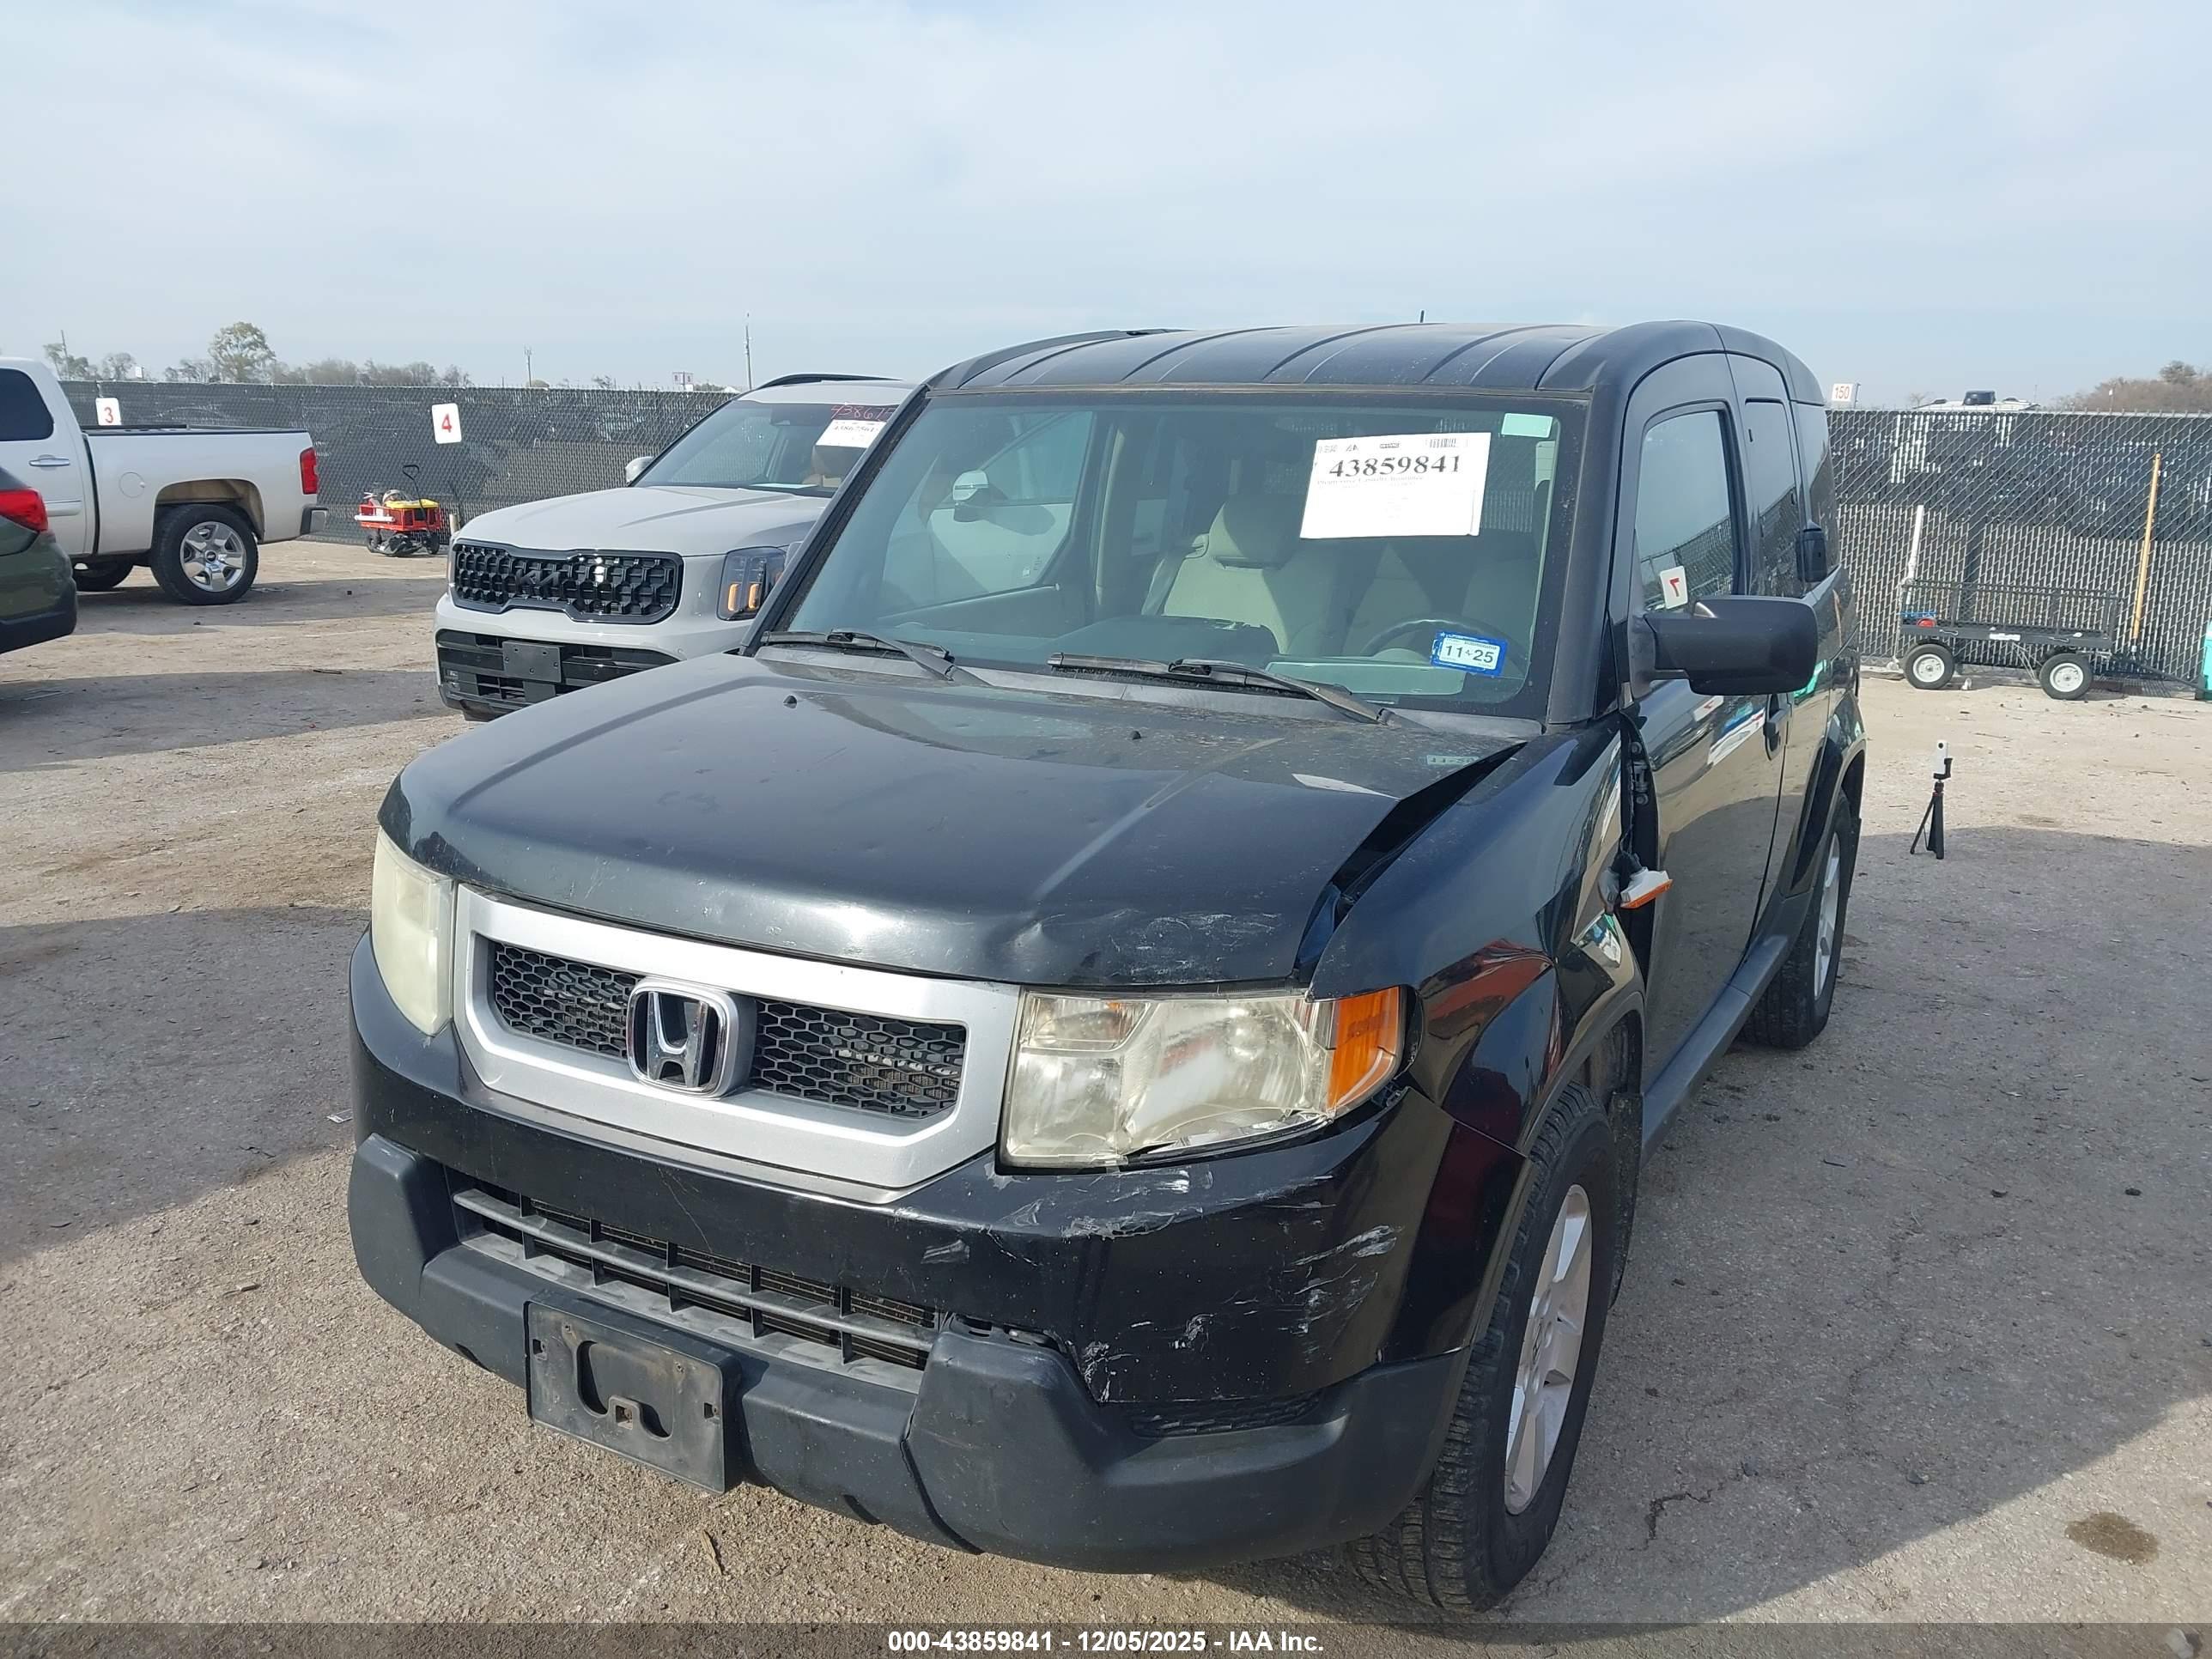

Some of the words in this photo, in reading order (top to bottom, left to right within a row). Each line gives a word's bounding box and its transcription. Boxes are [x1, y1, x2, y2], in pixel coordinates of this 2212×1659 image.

[1835, 386, 1850, 399] 150
[104, 407, 113, 423] 3
[441, 413, 452, 433] 4
[1329, 454, 1460, 477] 43859841
[1473, 649, 1494, 663] 25
